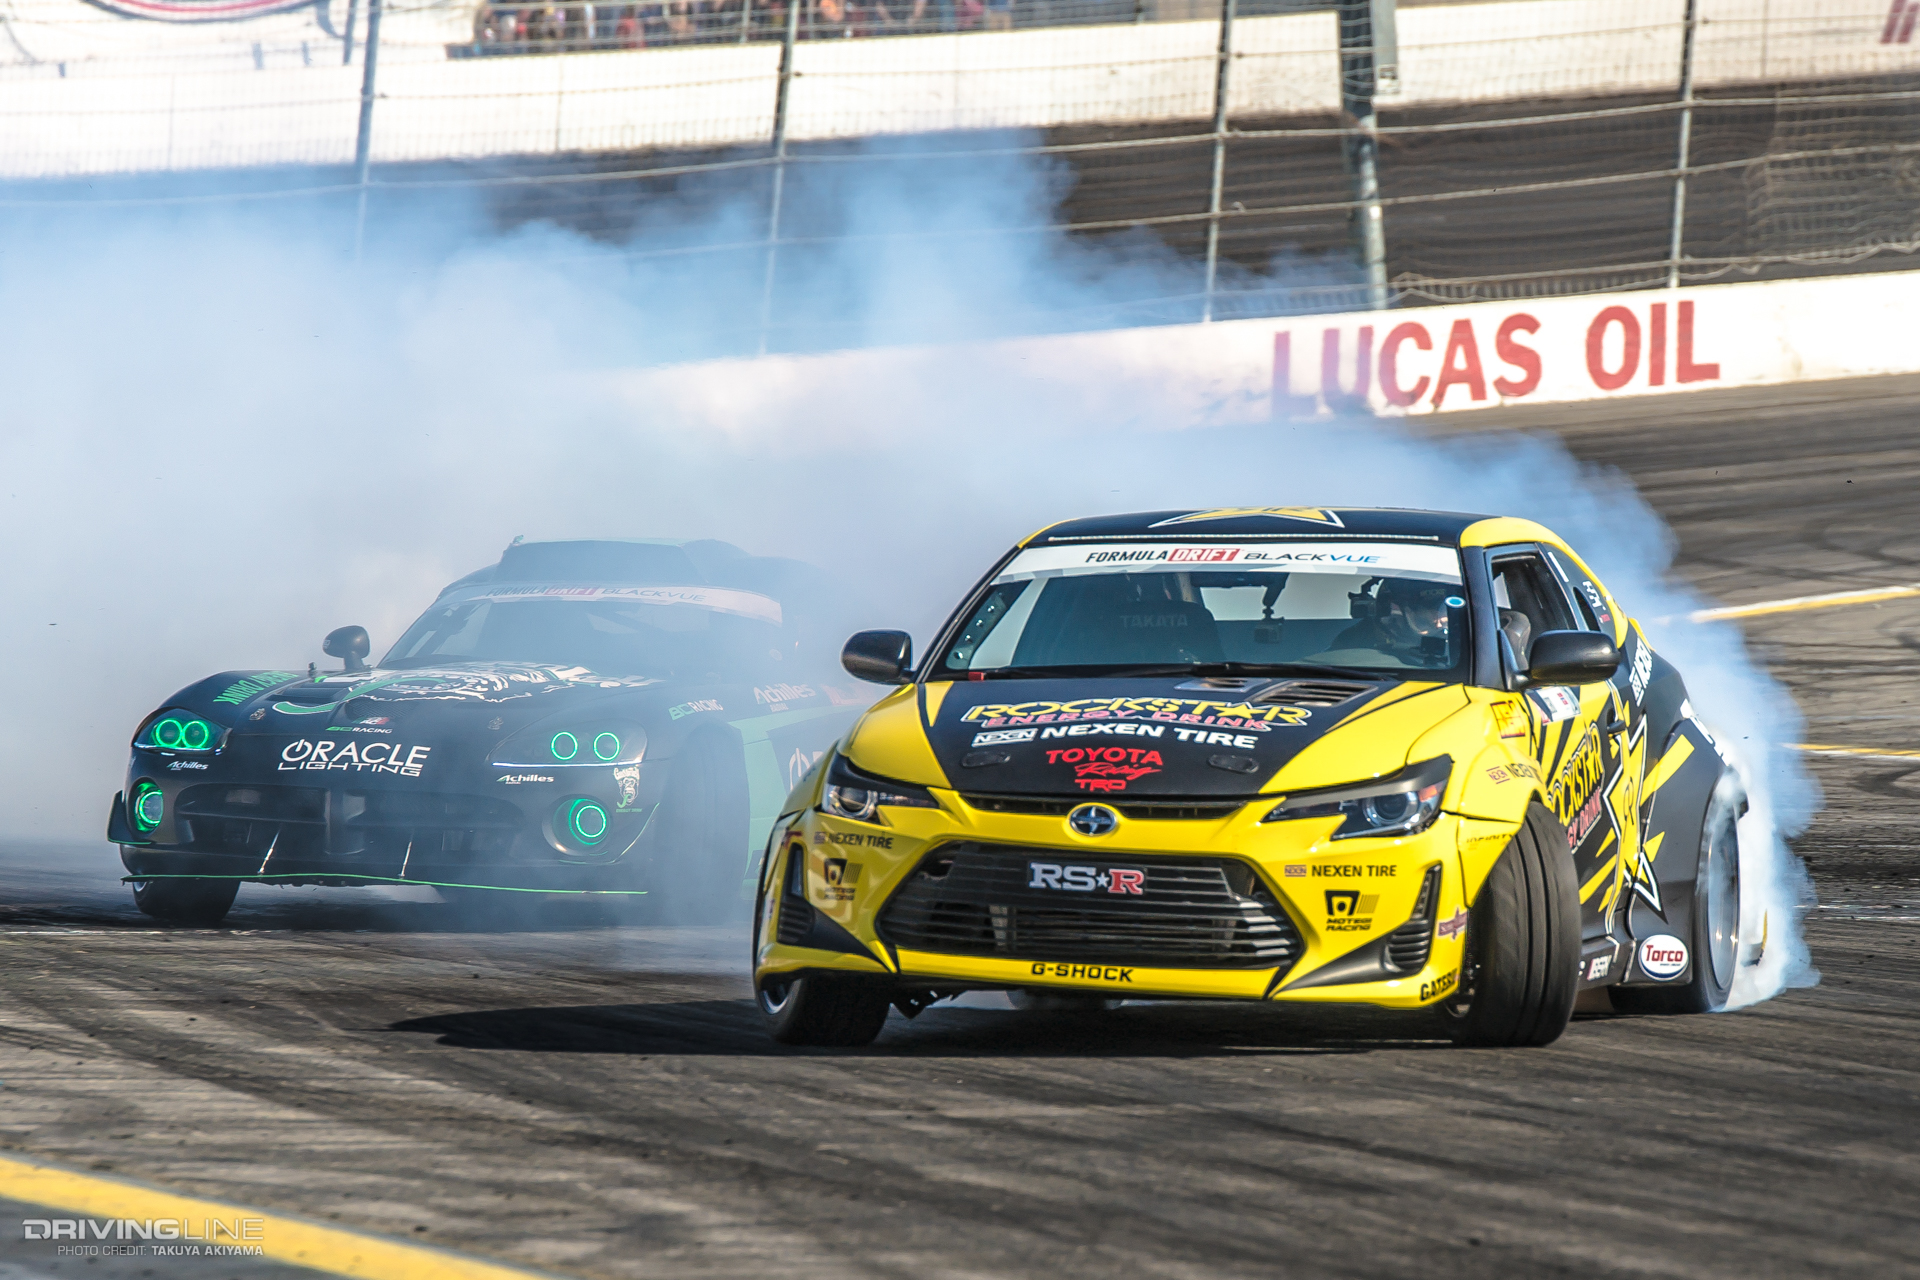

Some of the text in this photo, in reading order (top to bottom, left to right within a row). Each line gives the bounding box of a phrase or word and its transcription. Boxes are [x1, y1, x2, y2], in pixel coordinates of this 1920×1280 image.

[1271, 300, 1720, 417] LUCAS OIL
[1085, 549, 1380, 563] FORMULA DRIFT BLACKVUE
[486, 586, 547, 597] FORMULA
[601, 588, 708, 602] BLACKVUE
[1119, 613, 1188, 628] TAKATA
[754, 682, 817, 705] Achilles
[987, 709, 1268, 730] ENERGY DRINK
[1040, 723, 1166, 739] NEXEN
[1175, 727, 1259, 749] TIRE
[281, 738, 431, 768] ORACLE
[1046, 747, 1164, 766] TOYOTA
[166, 761, 209, 770] Achilles
[277, 761, 422, 777] LIGHTING
[496, 774, 554, 783] Achilles
[867, 835, 894, 849] TIRE
[1311, 865, 1362, 877] NEXEN
[1366, 865, 1397, 877] TIRE
[1326, 923, 1371, 931] RACING
[1646, 945, 1684, 962] Torco
[1031, 962, 1134, 982] G-SHOCK
